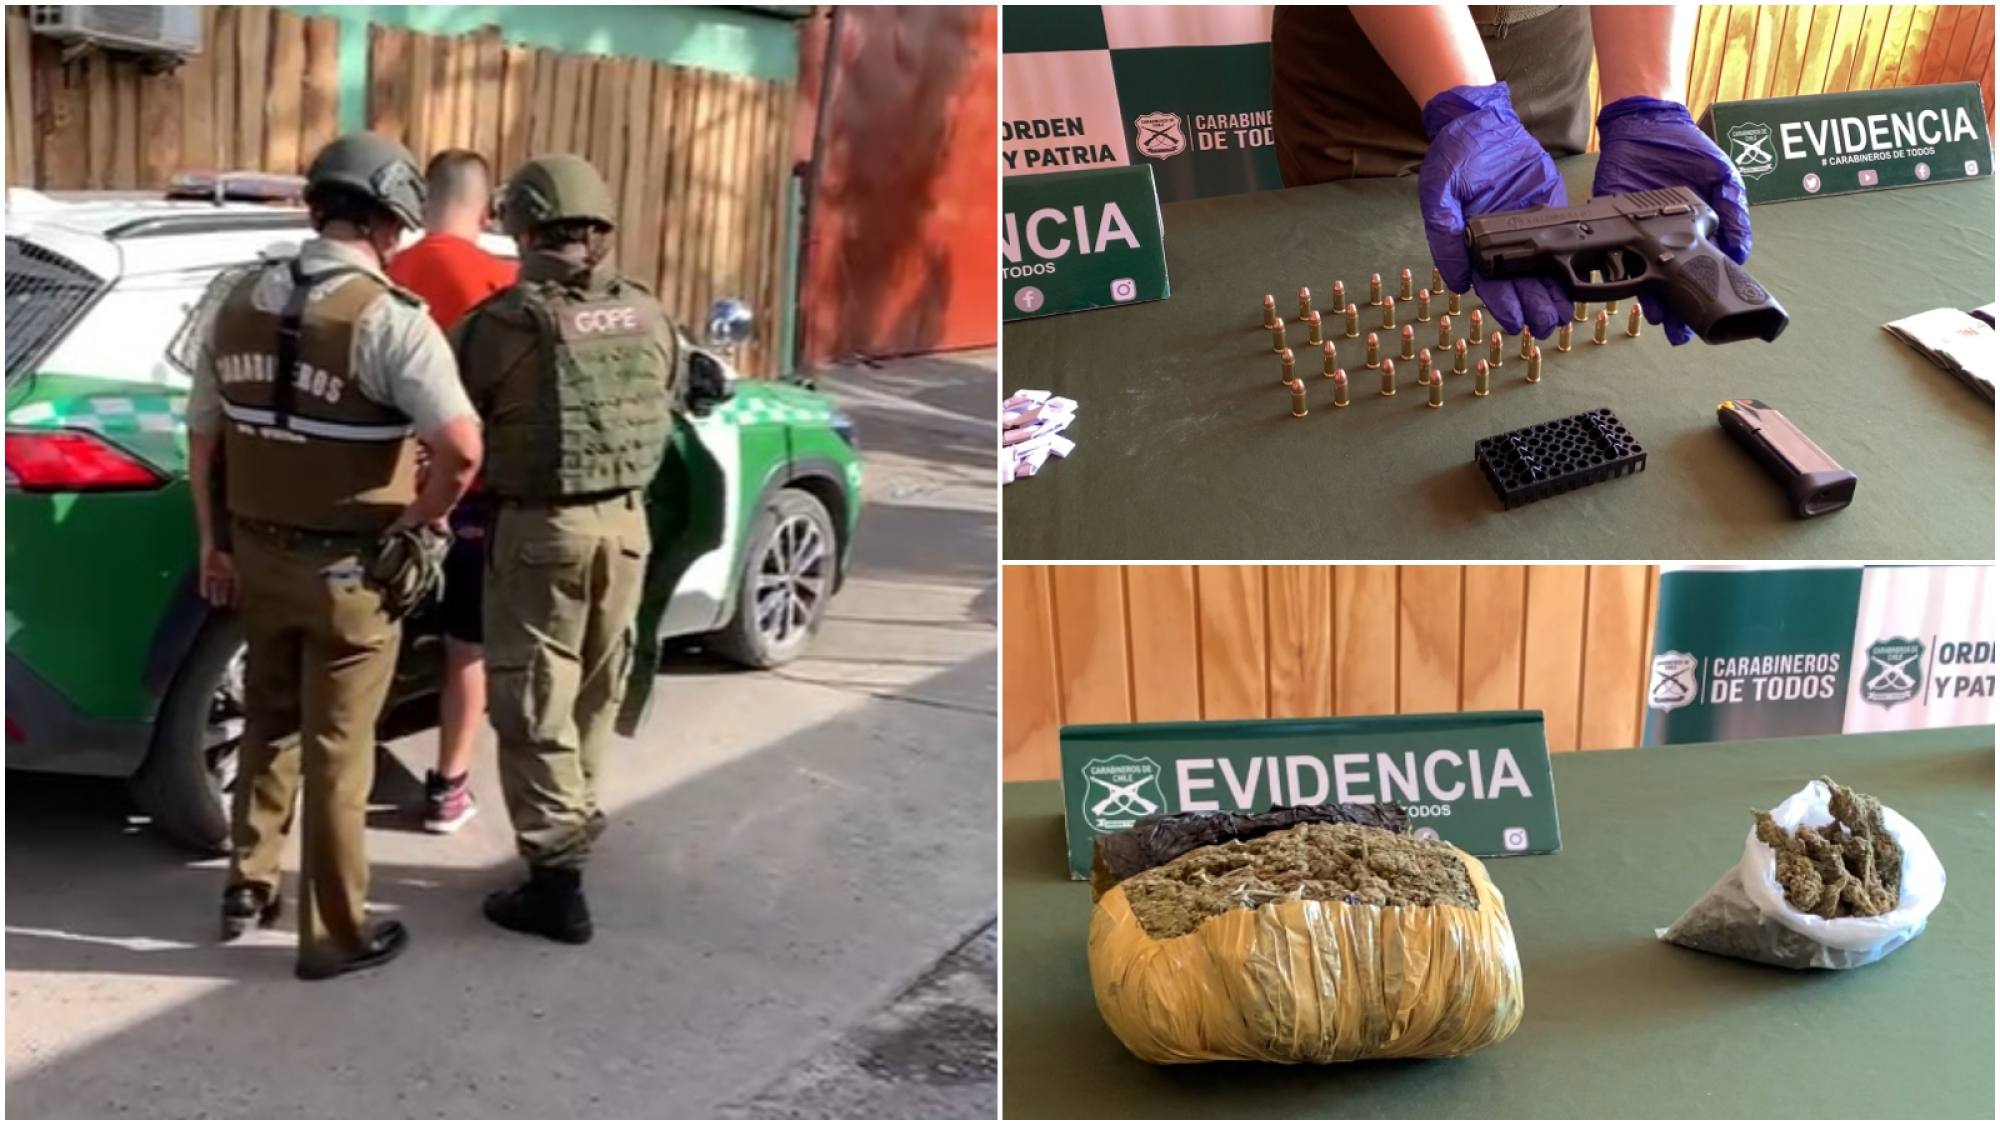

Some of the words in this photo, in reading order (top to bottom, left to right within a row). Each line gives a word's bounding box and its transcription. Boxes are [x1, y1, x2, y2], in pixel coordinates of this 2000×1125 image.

[1002, 117, 1085, 141] ORDEN
[1198, 131, 1229, 151] DE
[1779, 106, 1979, 160] EVIDENCIA
[1002, 150, 1018, 169] Y
[1024, 144, 1117, 168] PATRIA
[1829, 151, 1892, 166] CARABINEROS
[1893, 149, 1905, 159] DE
[1906, 146, 1936, 157] TODOS
[1002, 262, 1056, 279] TODOS
[574, 307, 637, 332] GOPE
[1713, 653, 1841, 677] CARABINEROS
[1939, 641, 1995, 665] ORD
[1710, 679, 1744, 704] DE
[1752, 674, 1836, 702] TODOS
[1935, 676, 1952, 698] Y
[1174, 748, 1533, 812] EVIDENCIA
[1401, 804, 1451, 818] ODOS
